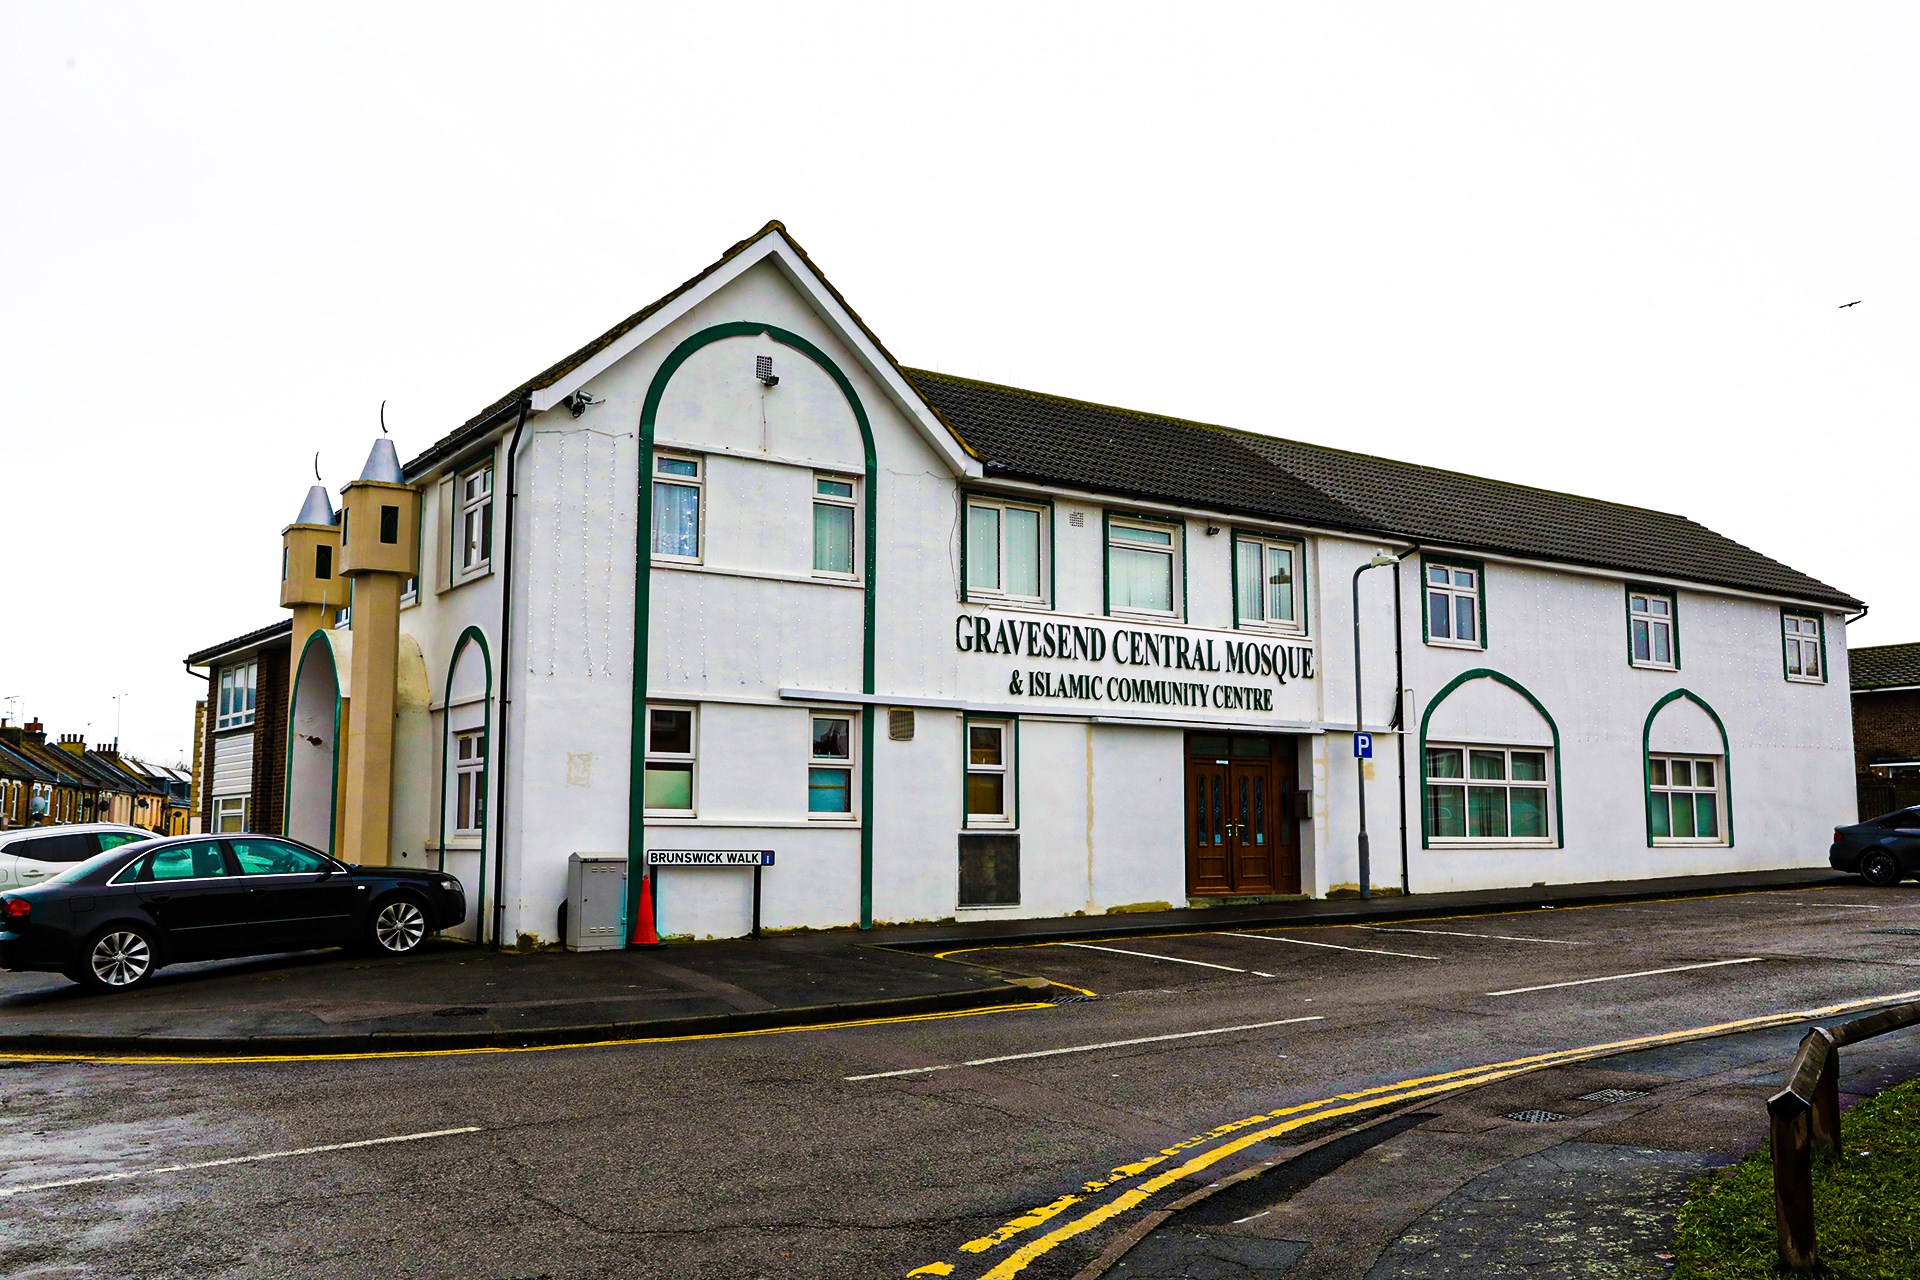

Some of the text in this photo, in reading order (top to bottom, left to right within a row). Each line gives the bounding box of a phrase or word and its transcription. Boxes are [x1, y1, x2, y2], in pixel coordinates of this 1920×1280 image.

[956, 614, 1315, 685] GRAVESEND CENTRAL MOSQUE
[1008, 669, 1273, 711] & ISLAMIC COMMUNITY CENTRE
[1358, 735, 1369, 755] P
[650, 852, 759, 863] BRUNSWICK WALK
